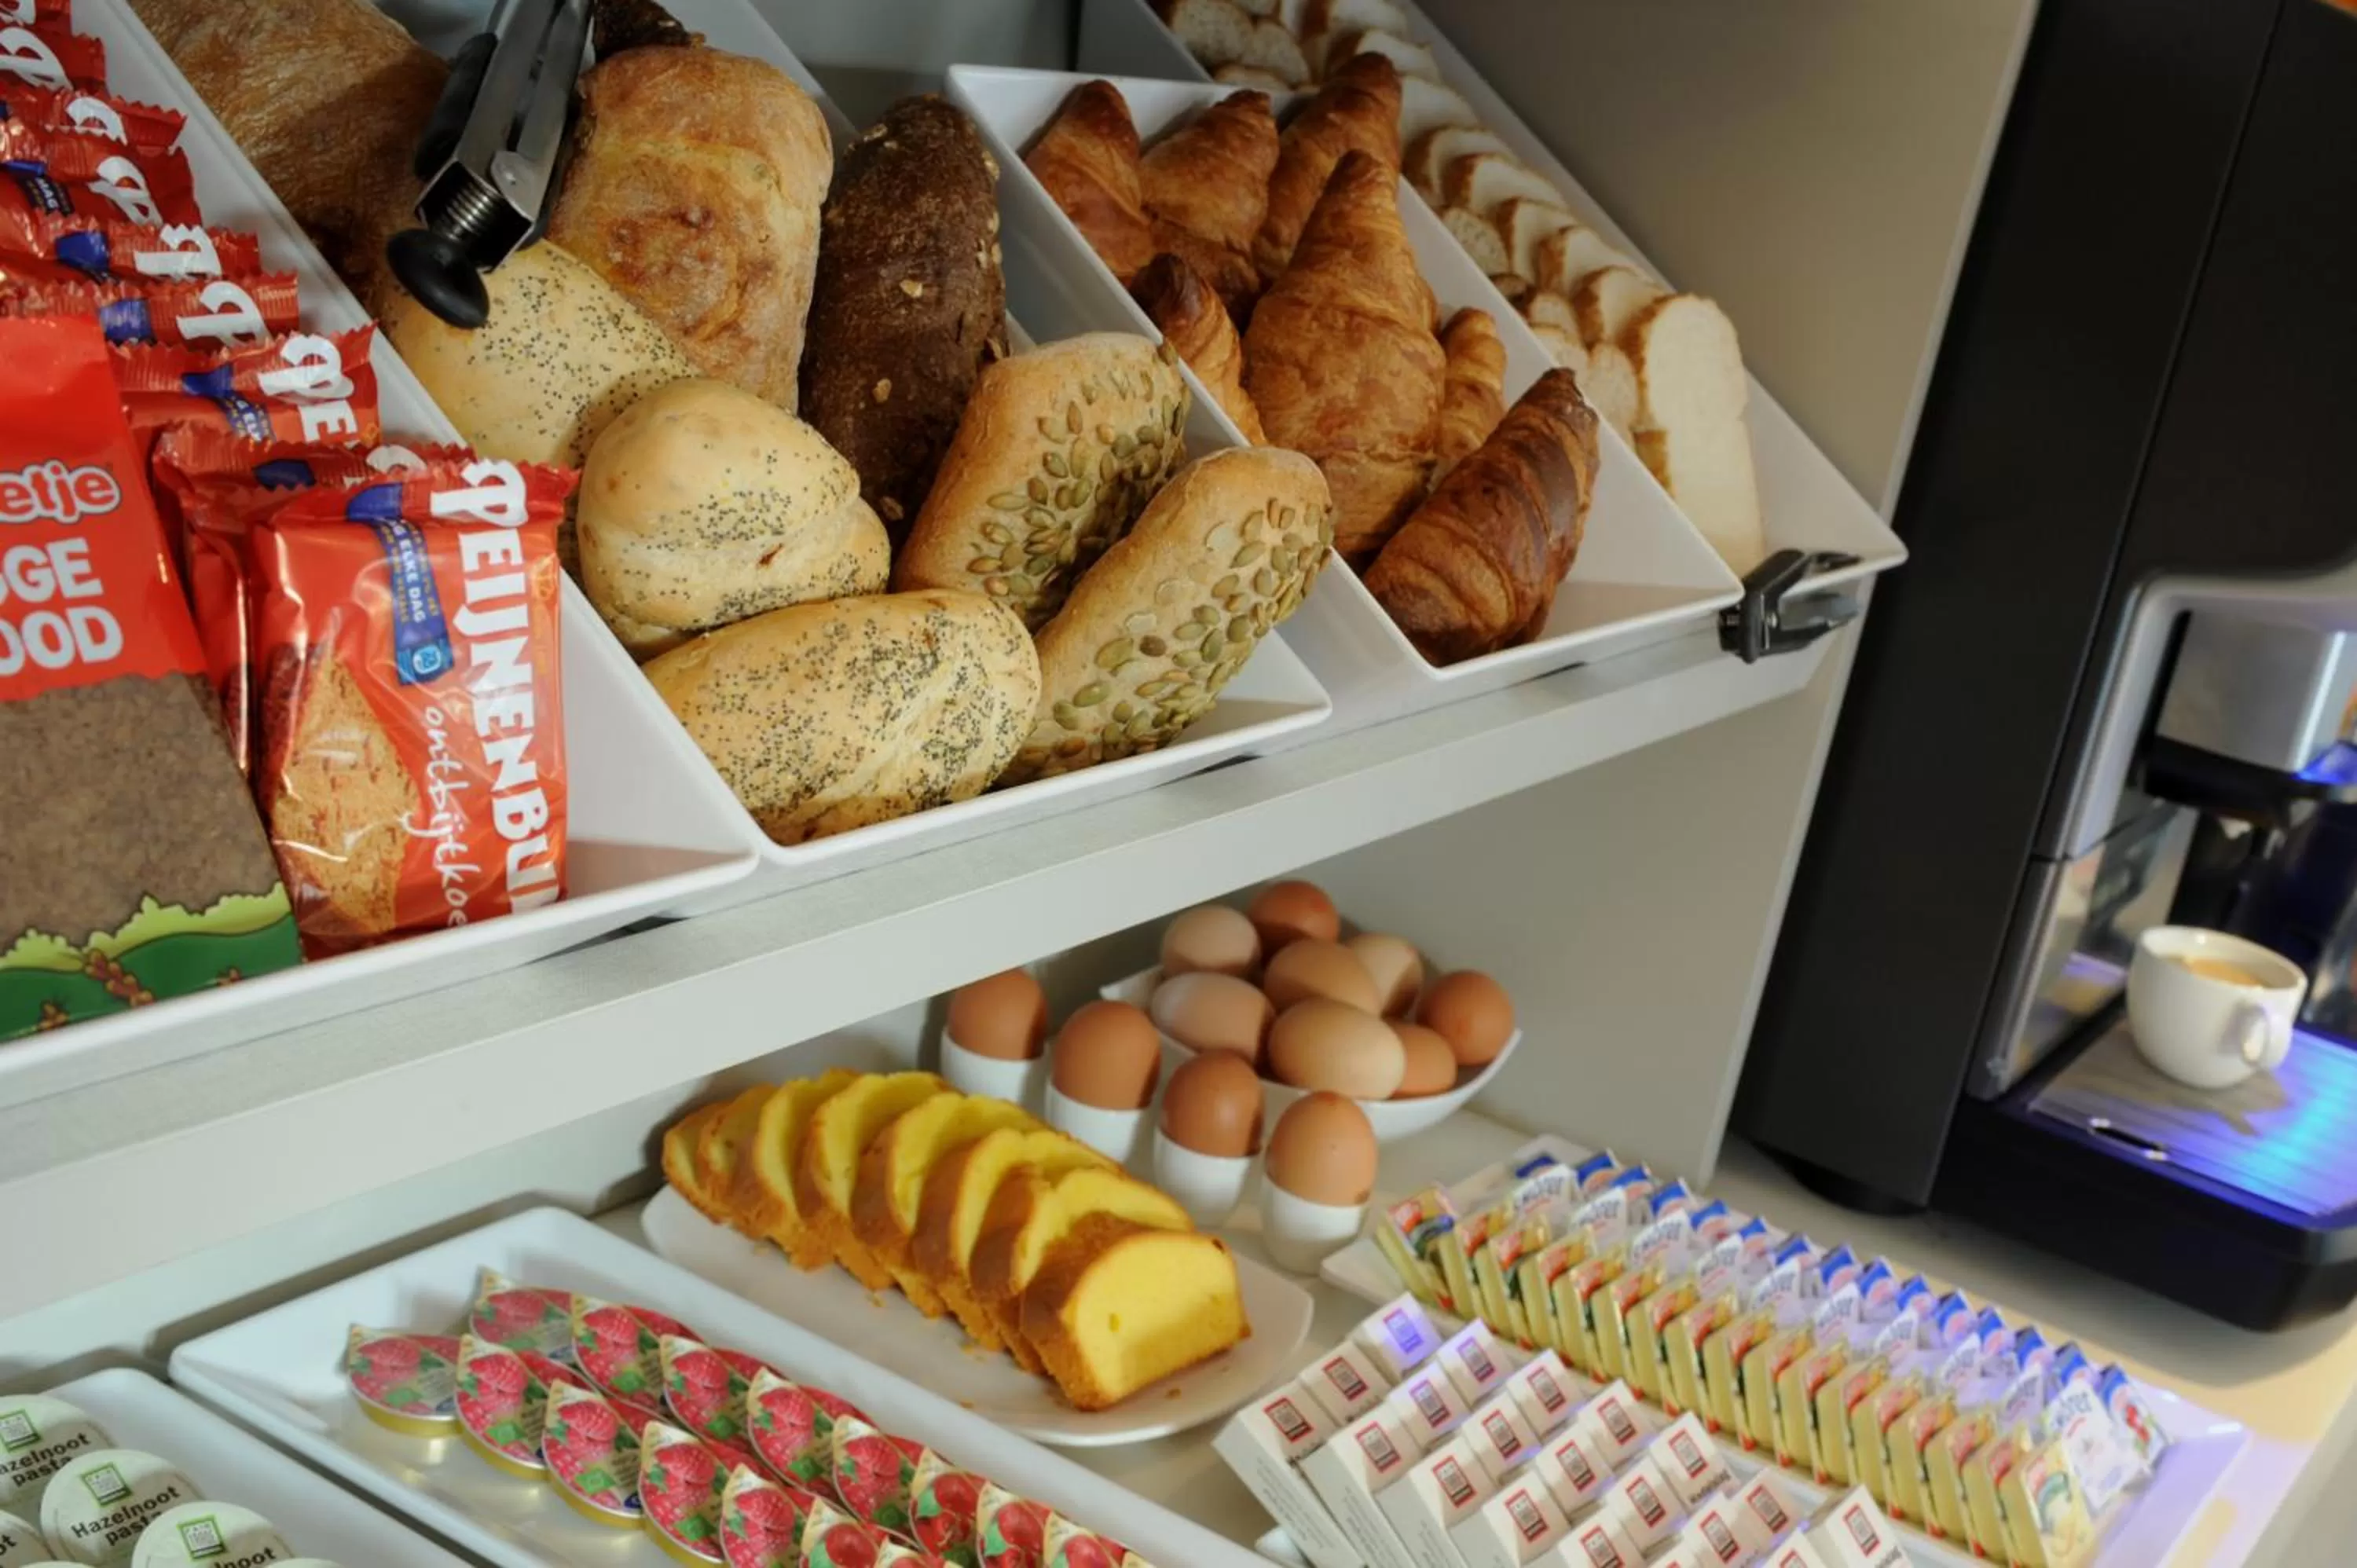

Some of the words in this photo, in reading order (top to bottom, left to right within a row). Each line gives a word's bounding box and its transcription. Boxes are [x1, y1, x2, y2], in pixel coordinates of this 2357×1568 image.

[0, 537, 104, 603] GE
[399, 538, 419, 583] ELKE
[408, 588, 426, 623] DAG
[70, 1486, 181, 1538] Hazelnoot
